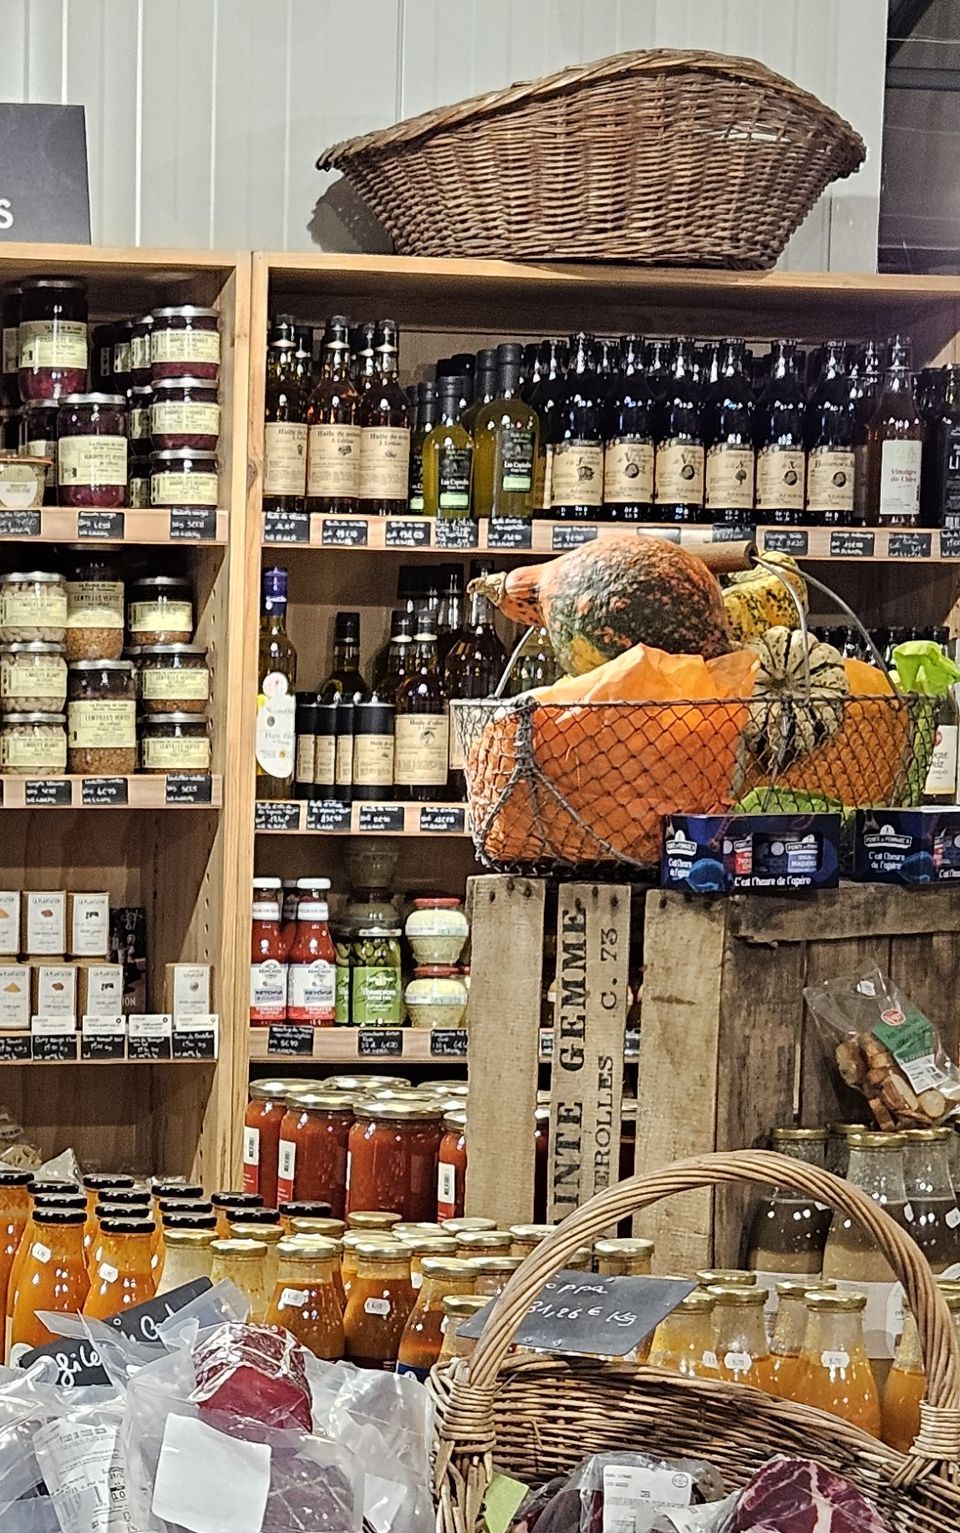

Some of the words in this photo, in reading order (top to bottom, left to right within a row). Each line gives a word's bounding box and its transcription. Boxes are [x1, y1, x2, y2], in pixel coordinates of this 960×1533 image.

[734, 877, 750, 887] C'est
[777, 876, 785, 886] de
[601, 927, 618, 962] 73
[559, 907, 587, 1073] GEMME
[553, 1101, 583, 1207] INTE
[545, 1282, 608, 1294] oppa
